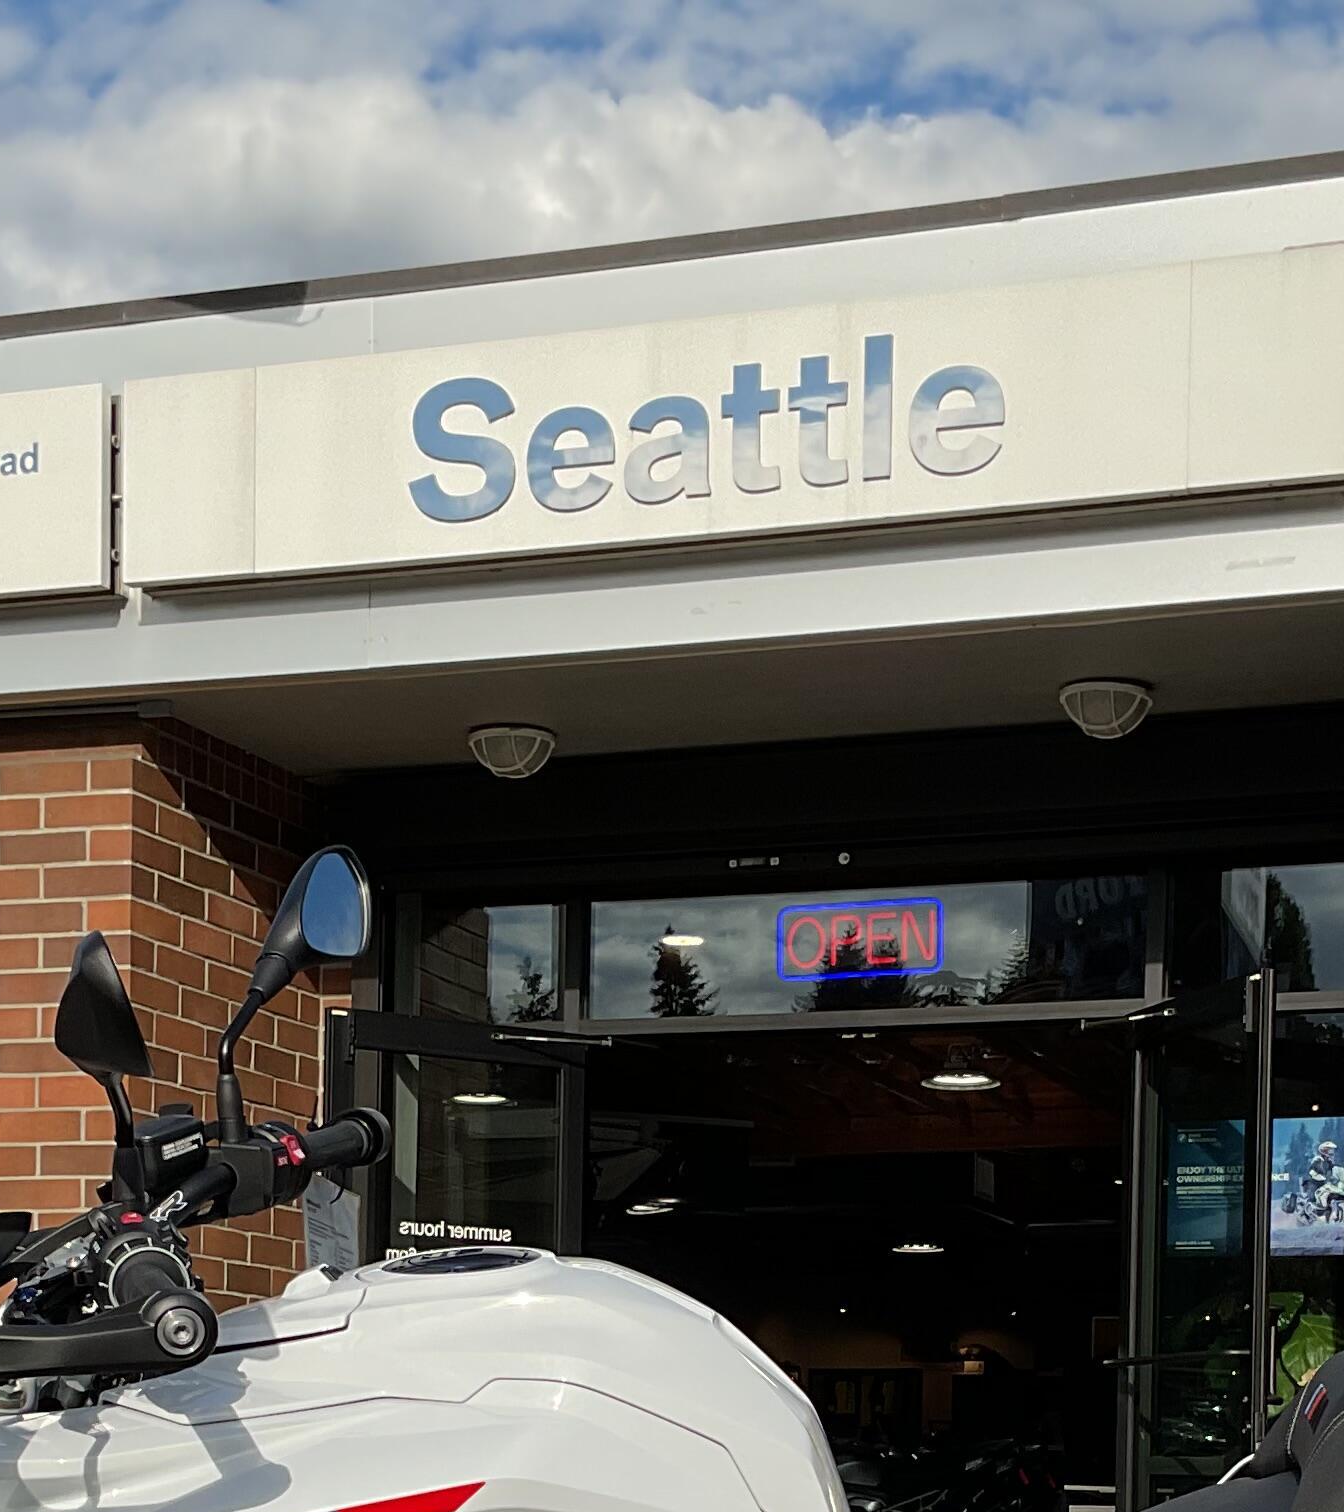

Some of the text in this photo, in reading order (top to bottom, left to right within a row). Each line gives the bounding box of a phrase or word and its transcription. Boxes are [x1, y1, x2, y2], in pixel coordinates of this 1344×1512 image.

[408, 333, 1006, 524] Seattle
[787, 909, 937, 969] OPEN
[1208, 1166, 1225, 1174] THE
